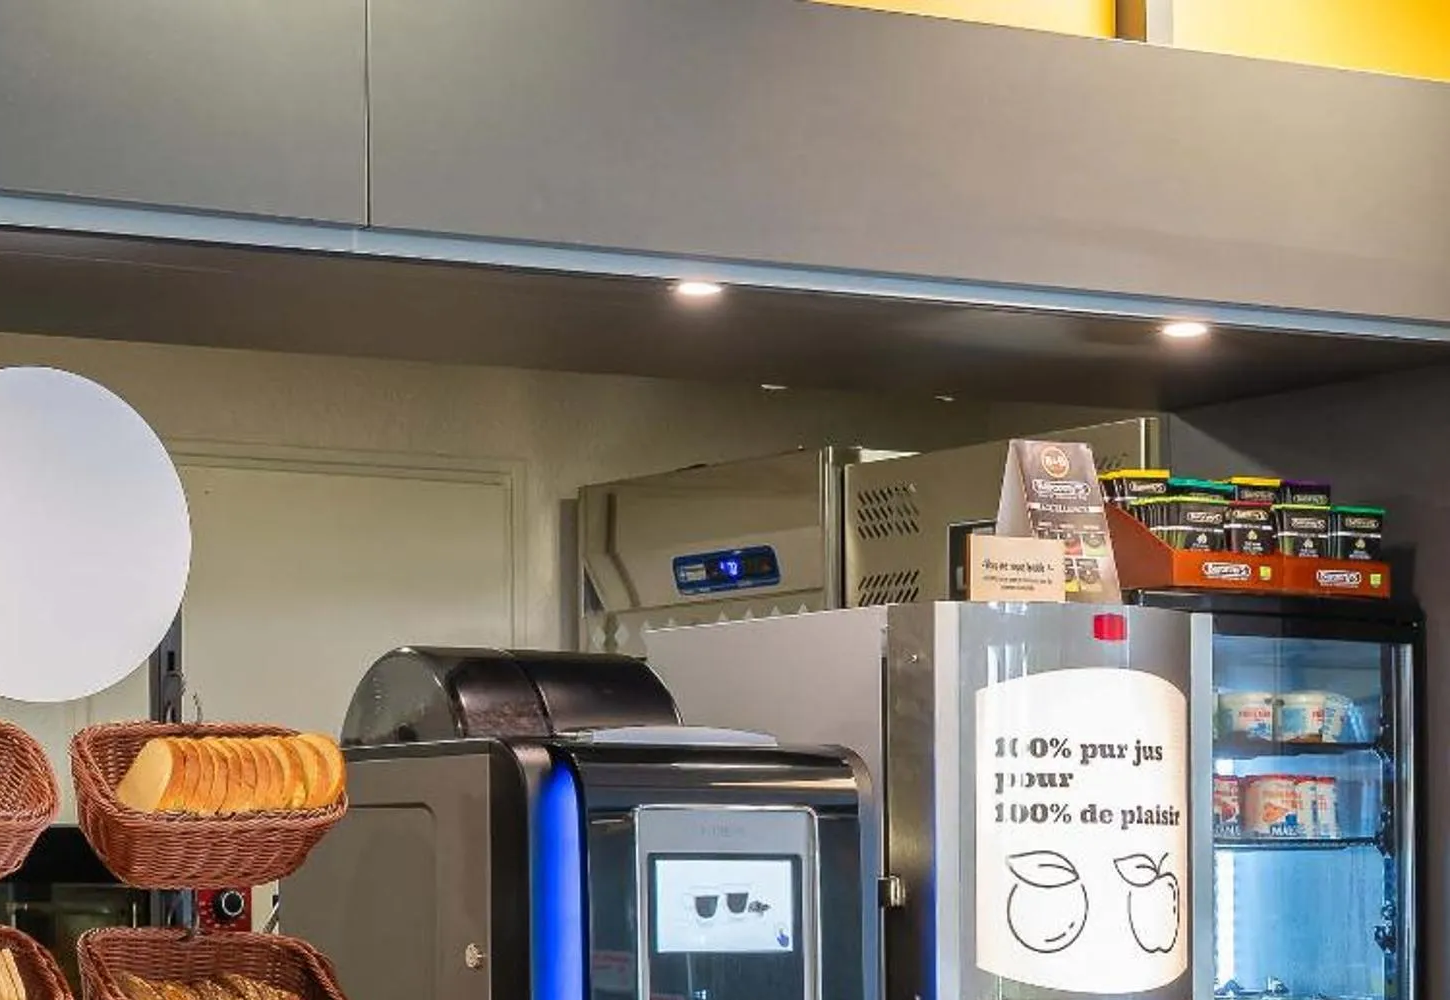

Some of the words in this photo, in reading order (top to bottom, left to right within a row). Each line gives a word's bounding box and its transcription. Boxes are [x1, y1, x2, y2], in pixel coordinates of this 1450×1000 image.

[1080, 743, 1128, 765] pur
[1133, 739, 1163, 766] jus
[995, 802, 1072, 823] 100%
[1080, 804, 1113, 824] de
[1121, 804, 1180, 830] plaisir
